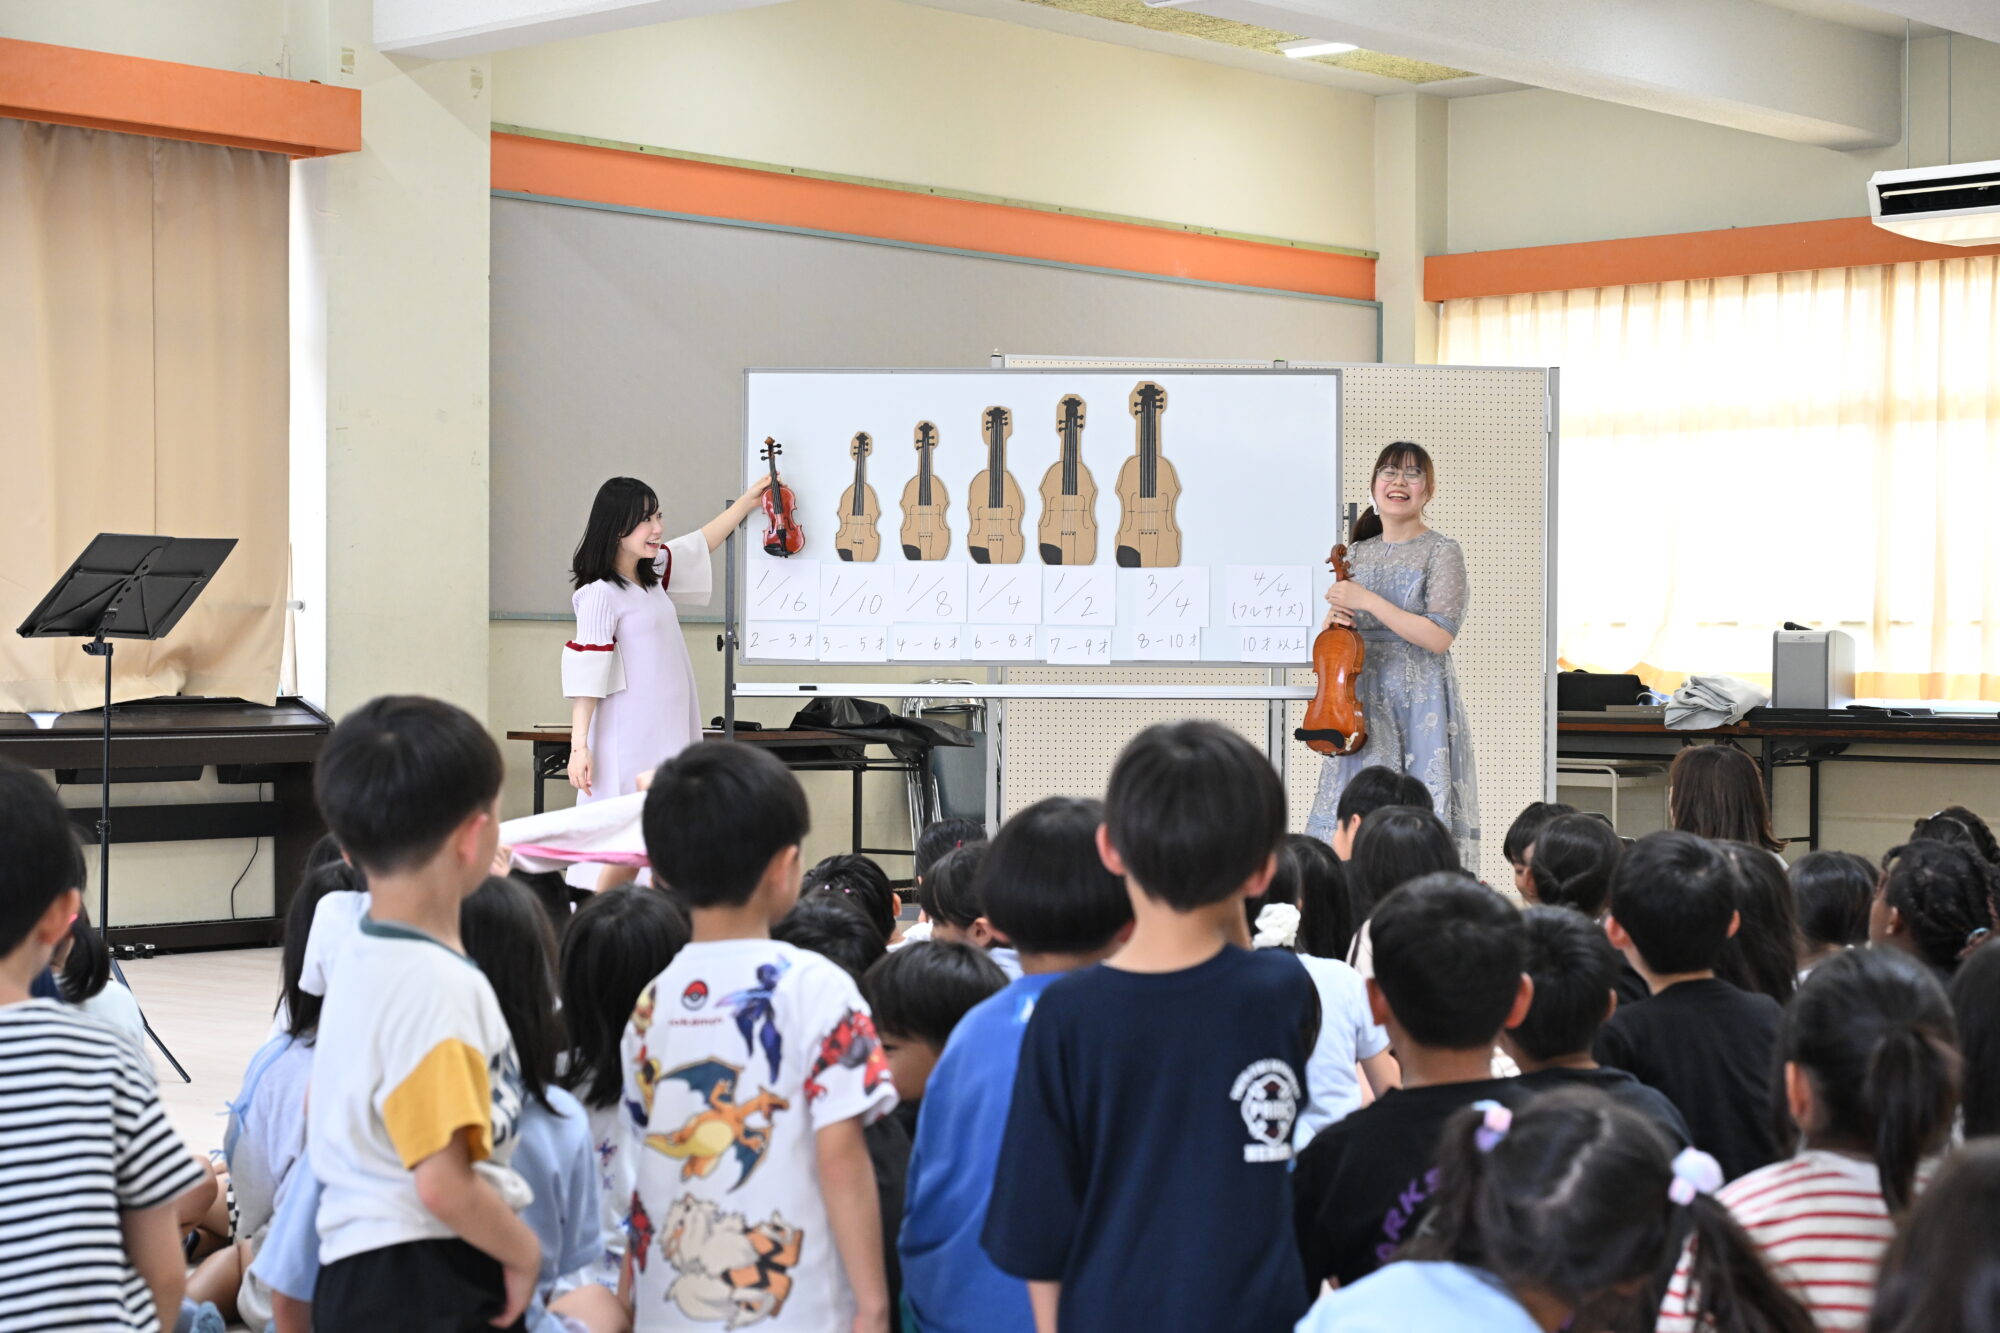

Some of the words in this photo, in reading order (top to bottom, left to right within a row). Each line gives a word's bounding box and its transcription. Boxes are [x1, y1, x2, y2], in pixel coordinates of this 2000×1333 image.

[757, 568, 807, 611] 1/16
[830, 575, 883, 616] 1/10
[906, 573, 952, 616] 1/8
[978, 573, 1022, 614] 1/4
[1054, 572, 1098, 617] 1/2
[1147, 574, 1192, 617] 3/4
[1254, 572, 1291, 598] 4/4
